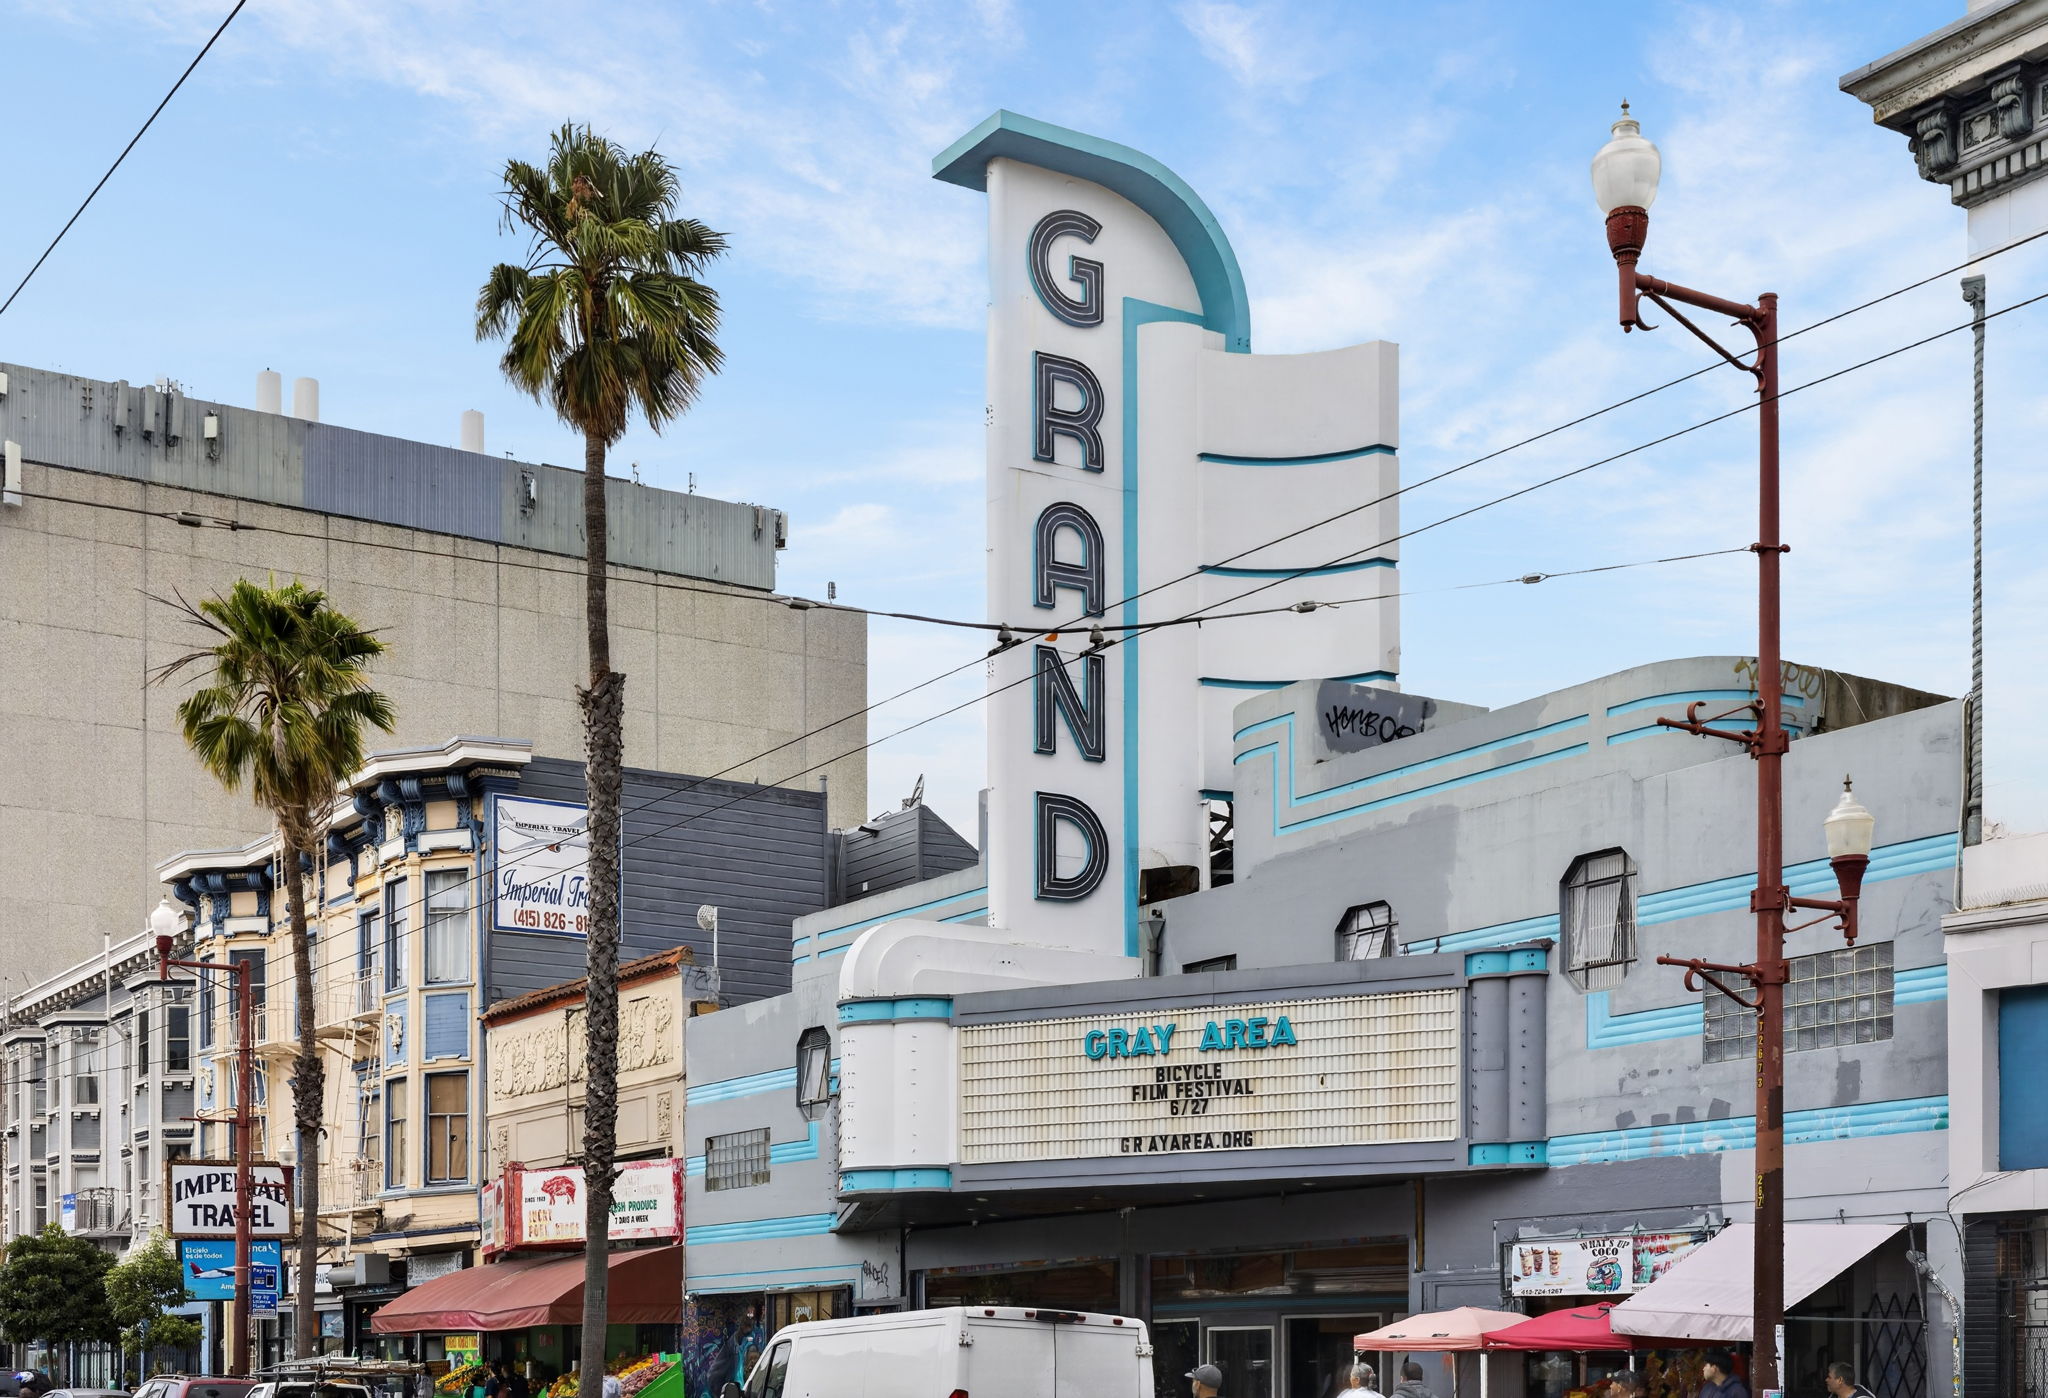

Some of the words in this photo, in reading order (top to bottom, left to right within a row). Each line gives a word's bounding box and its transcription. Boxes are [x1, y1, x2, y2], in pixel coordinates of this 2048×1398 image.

[1027, 209, 1109, 901] GRAND
[515, 821, 550, 832] IMPERIAL
[552, 825, 580, 835] TRAVEL
[500, 868, 566, 908] Imperial
[567, 876, 590, 908] Tra
[513, 908, 540, 928] (415)
[1084, 1023, 1176, 1061] GRAY
[1199, 1015, 1297, 1052] AREA
[1156, 1062, 1222, 1083] BICYCLE
[1132, 1083, 1168, 1102] FILM
[1175, 1078, 1254, 1099] FESTIVAL
[1170, 1098, 1209, 1116] 6/27
[1120, 1131, 1253, 1153] GRAYAREA.ORG
[187, 1204, 275, 1227] TRAEL
[628, 1199, 658, 1212] PRODUCE
[619, 1216, 630, 1224] DAYS
[631, 1215, 635, 1223] A
[635, 1214, 649, 1223] WEEK
[1579, 1239, 1614, 1251] WHAT'S
[1616, 1239, 1630, 1249] UP
[1591, 1247, 1619, 1257] COCO
